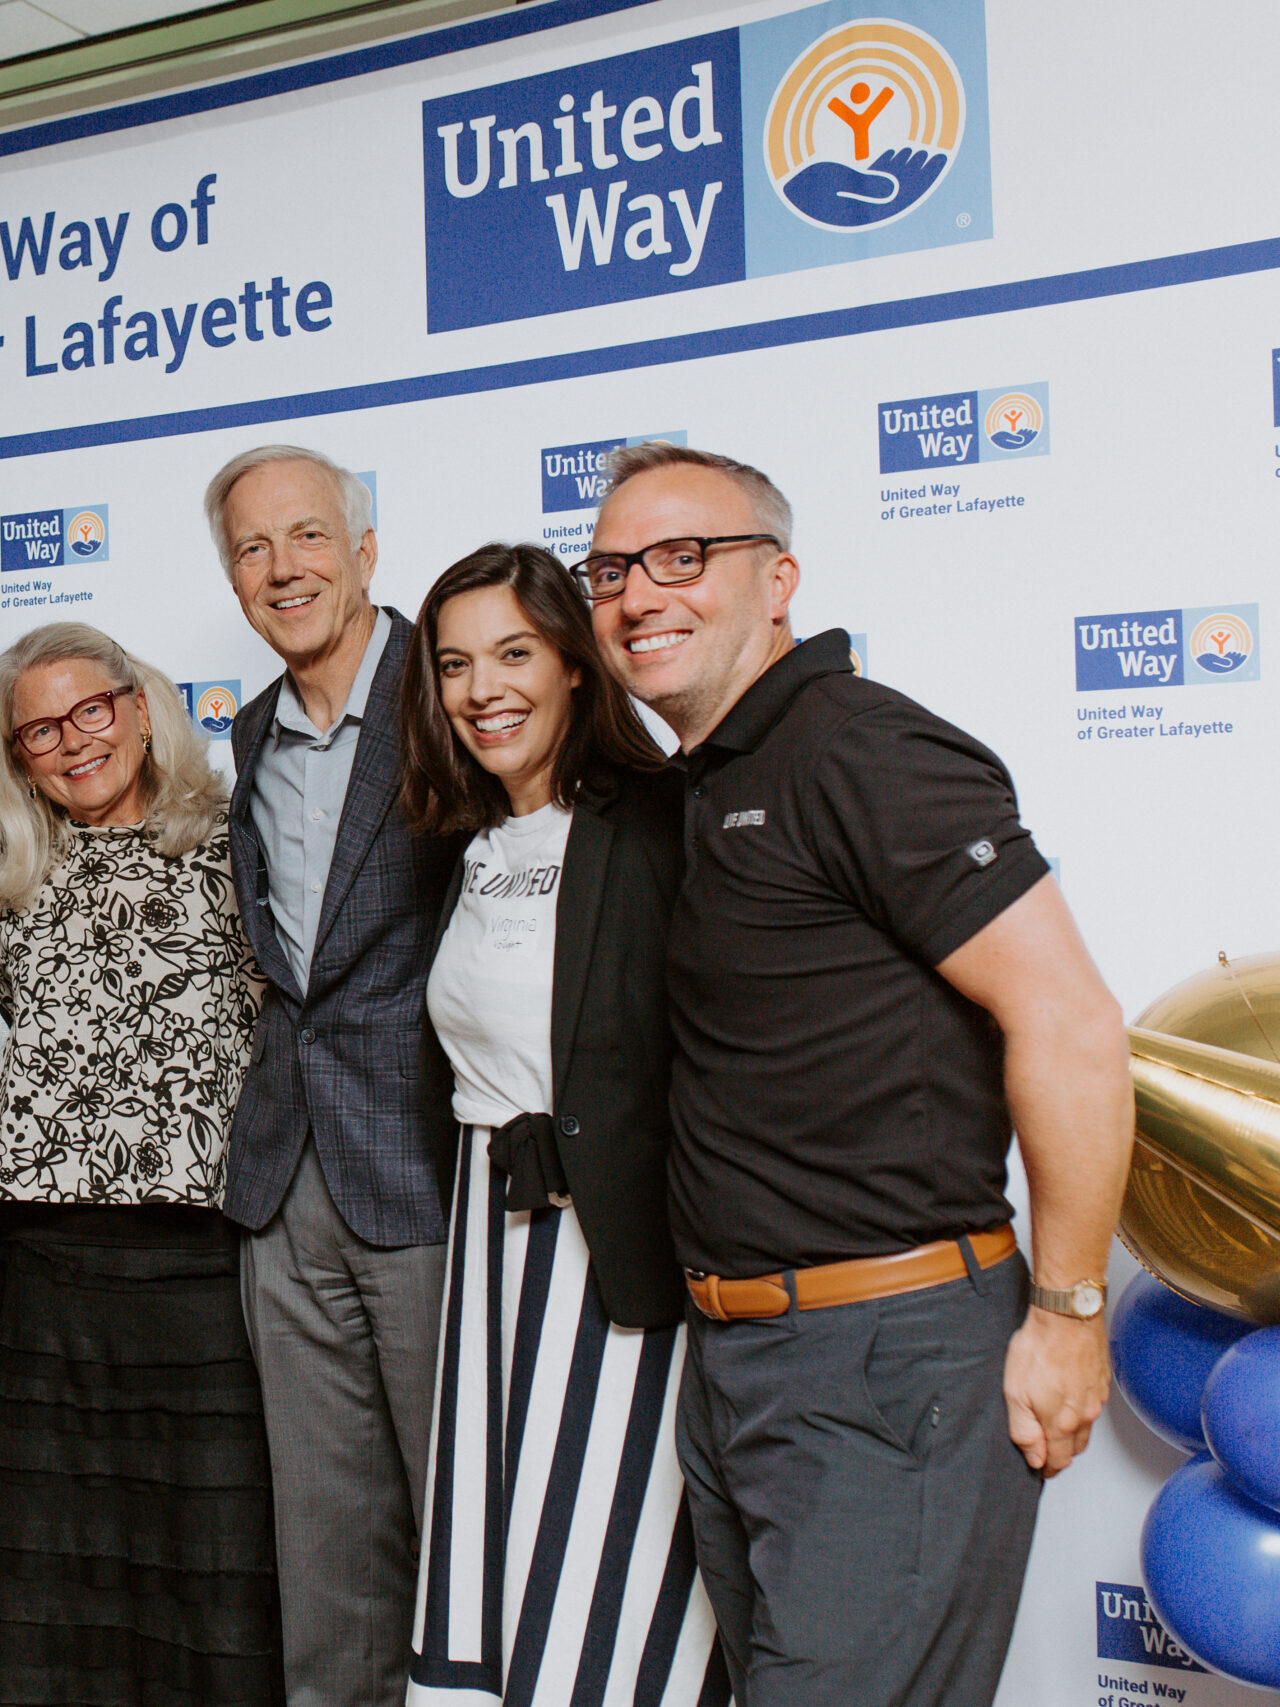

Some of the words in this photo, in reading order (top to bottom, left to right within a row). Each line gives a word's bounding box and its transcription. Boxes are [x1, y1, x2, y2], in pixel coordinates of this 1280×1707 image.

[437, 60, 722, 198] United
[0, 211, 130, 283] Way
[150, 173, 218, 252] of
[546, 180, 723, 277] Way
[25, 276, 334, 378] Lafayette
[881, 399, 973, 435] United
[917, 431, 974, 462] Way
[880, 485, 926, 502] United
[930, 483, 961, 497] Way
[880, 506, 895, 521] of
[899, 503, 953, 519] Greater
[956, 495, 1026, 513] Lafayette
[2, 515, 61, 541] United
[543, 523, 583, 539] United
[25, 540, 61, 564] Way
[559, 541, 593, 554] Great
[1, 581, 31, 595] United
[32, 581, 53, 593] Way
[1, 597, 11, 609] of
[12, 596, 47, 608] Greater
[49, 591, 94, 605] Lafayette
[1078, 617, 1178, 650] United
[1117, 650, 1178, 683] Way
[1077, 706, 1126, 721] United
[1131, 705, 1163, 720] Way
[1077, 726, 1092, 741] of
[1097, 726, 1155, 740] Greater
[1159, 721, 1234, 739] Lafayette
[1098, 1674, 1148, 1695] United
[1153, 1682, 1186, 1703] Way
[1098, 1695, 1114, 1707] of
